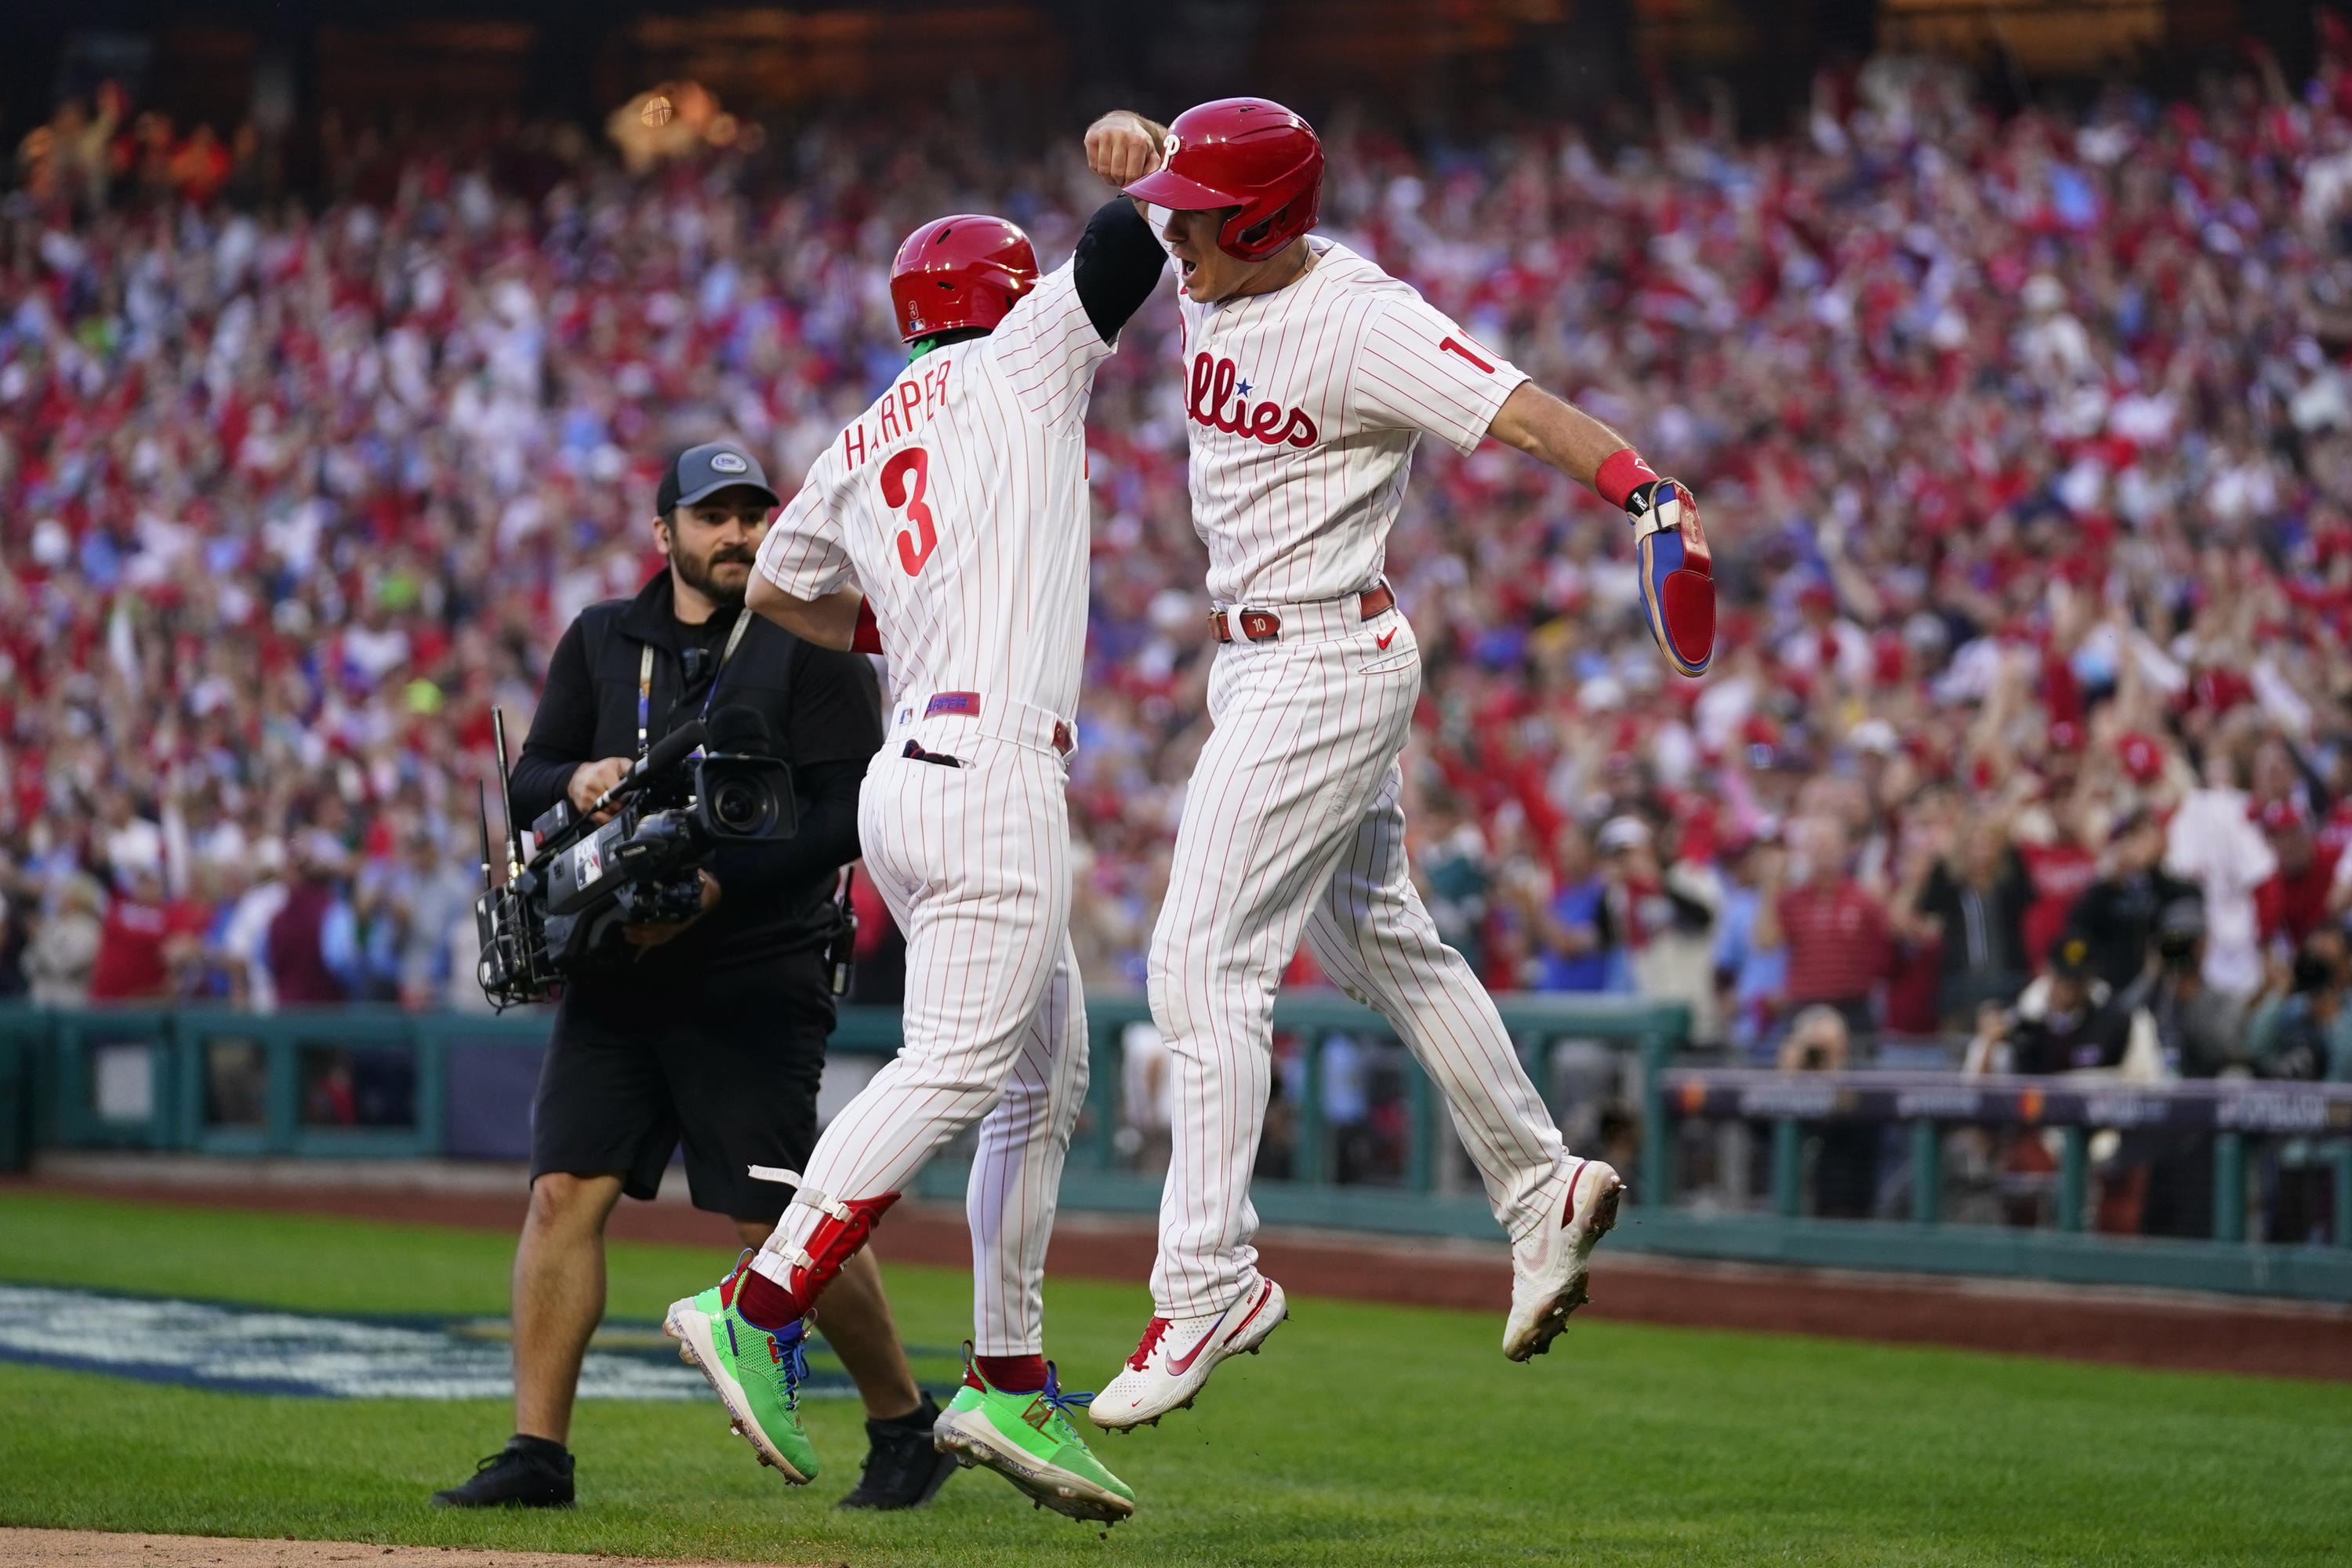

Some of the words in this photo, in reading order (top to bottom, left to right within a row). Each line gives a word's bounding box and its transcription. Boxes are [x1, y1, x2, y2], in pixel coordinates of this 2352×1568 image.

[1160, 134, 1181, 171] P
[909, 300, 919, 320] 3
[1439, 328, 1505, 374] 1
[880, 447, 938, 578] 3
[1252, 618, 1266, 632] 10
[575, 832, 599, 865] FOX
